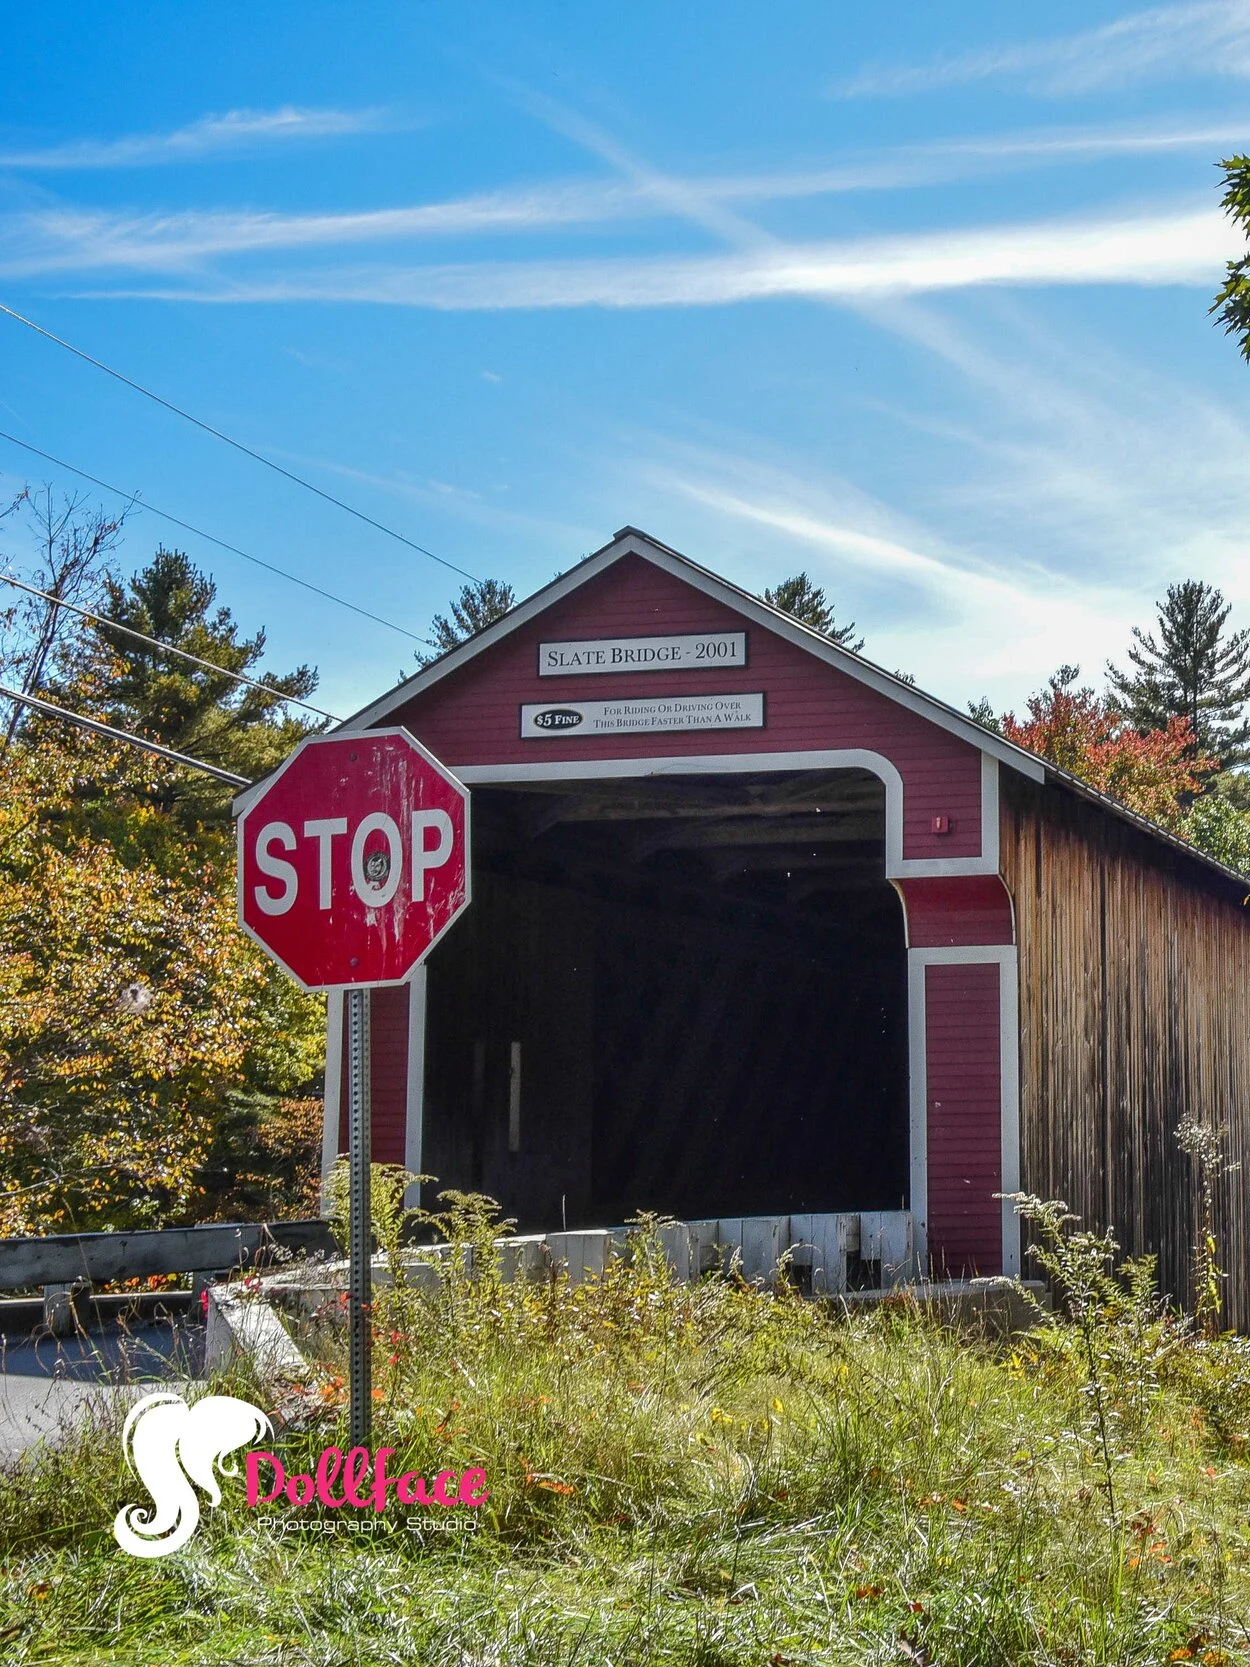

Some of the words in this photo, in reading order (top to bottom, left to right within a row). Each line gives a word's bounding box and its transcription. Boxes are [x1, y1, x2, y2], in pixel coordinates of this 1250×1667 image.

[547, 650, 605, 667] SLATE
[610, 646, 682, 664] BRIDGE
[695, 641, 737, 659] 2001
[603, 706, 622, 716] FOR
[715, 701, 742, 711] OVER
[536, 713, 552, 727] $5
[554, 714, 580, 725] FINE
[593, 719, 615, 728] THIS
[616, 718, 650, 728] BRIDGE
[651, 716, 685, 726] FASTER
[685, 714, 713, 724] THAN
[714, 714, 722, 723] A
[723, 713, 752, 722] WALK
[254, 808, 454, 916] STOP
